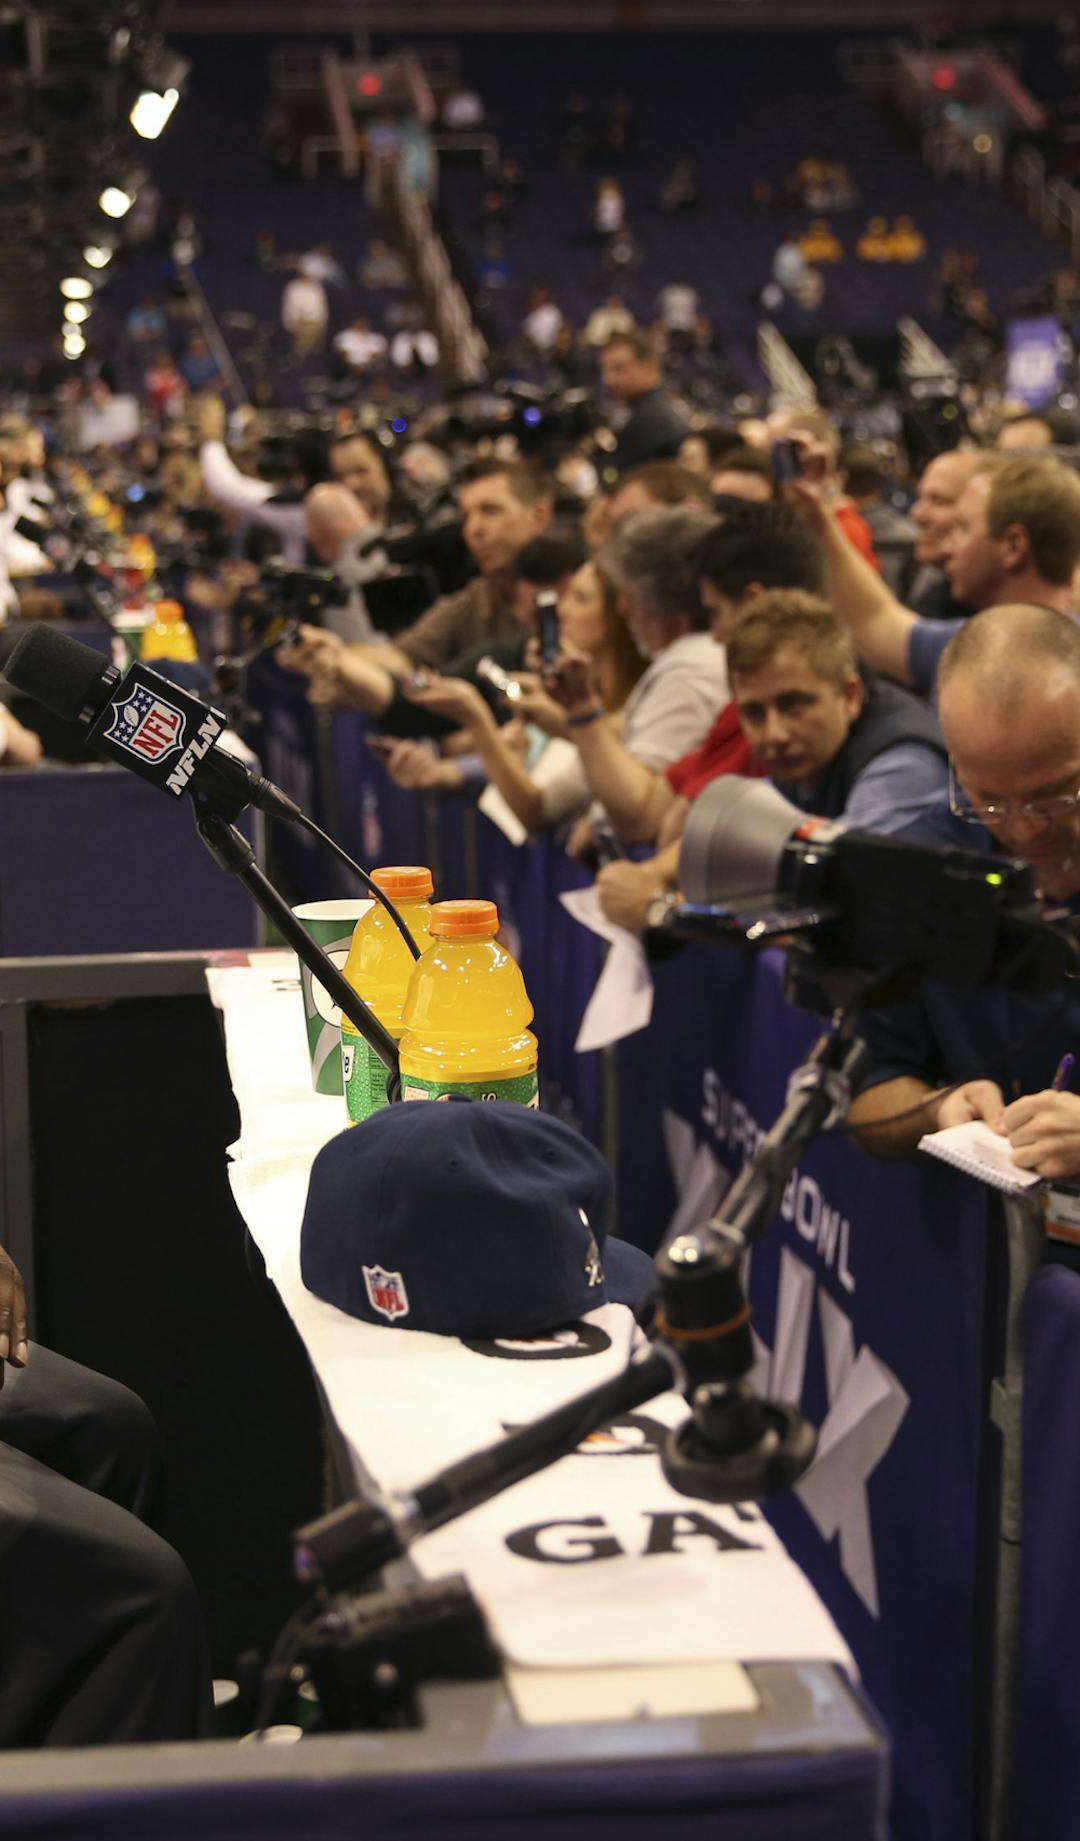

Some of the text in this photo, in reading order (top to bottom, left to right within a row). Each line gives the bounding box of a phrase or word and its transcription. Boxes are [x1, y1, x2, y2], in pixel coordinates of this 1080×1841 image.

[132, 709, 181, 757] NFL
[165, 713, 222, 796] NFLN
[373, 1287, 406, 1312] NFL
